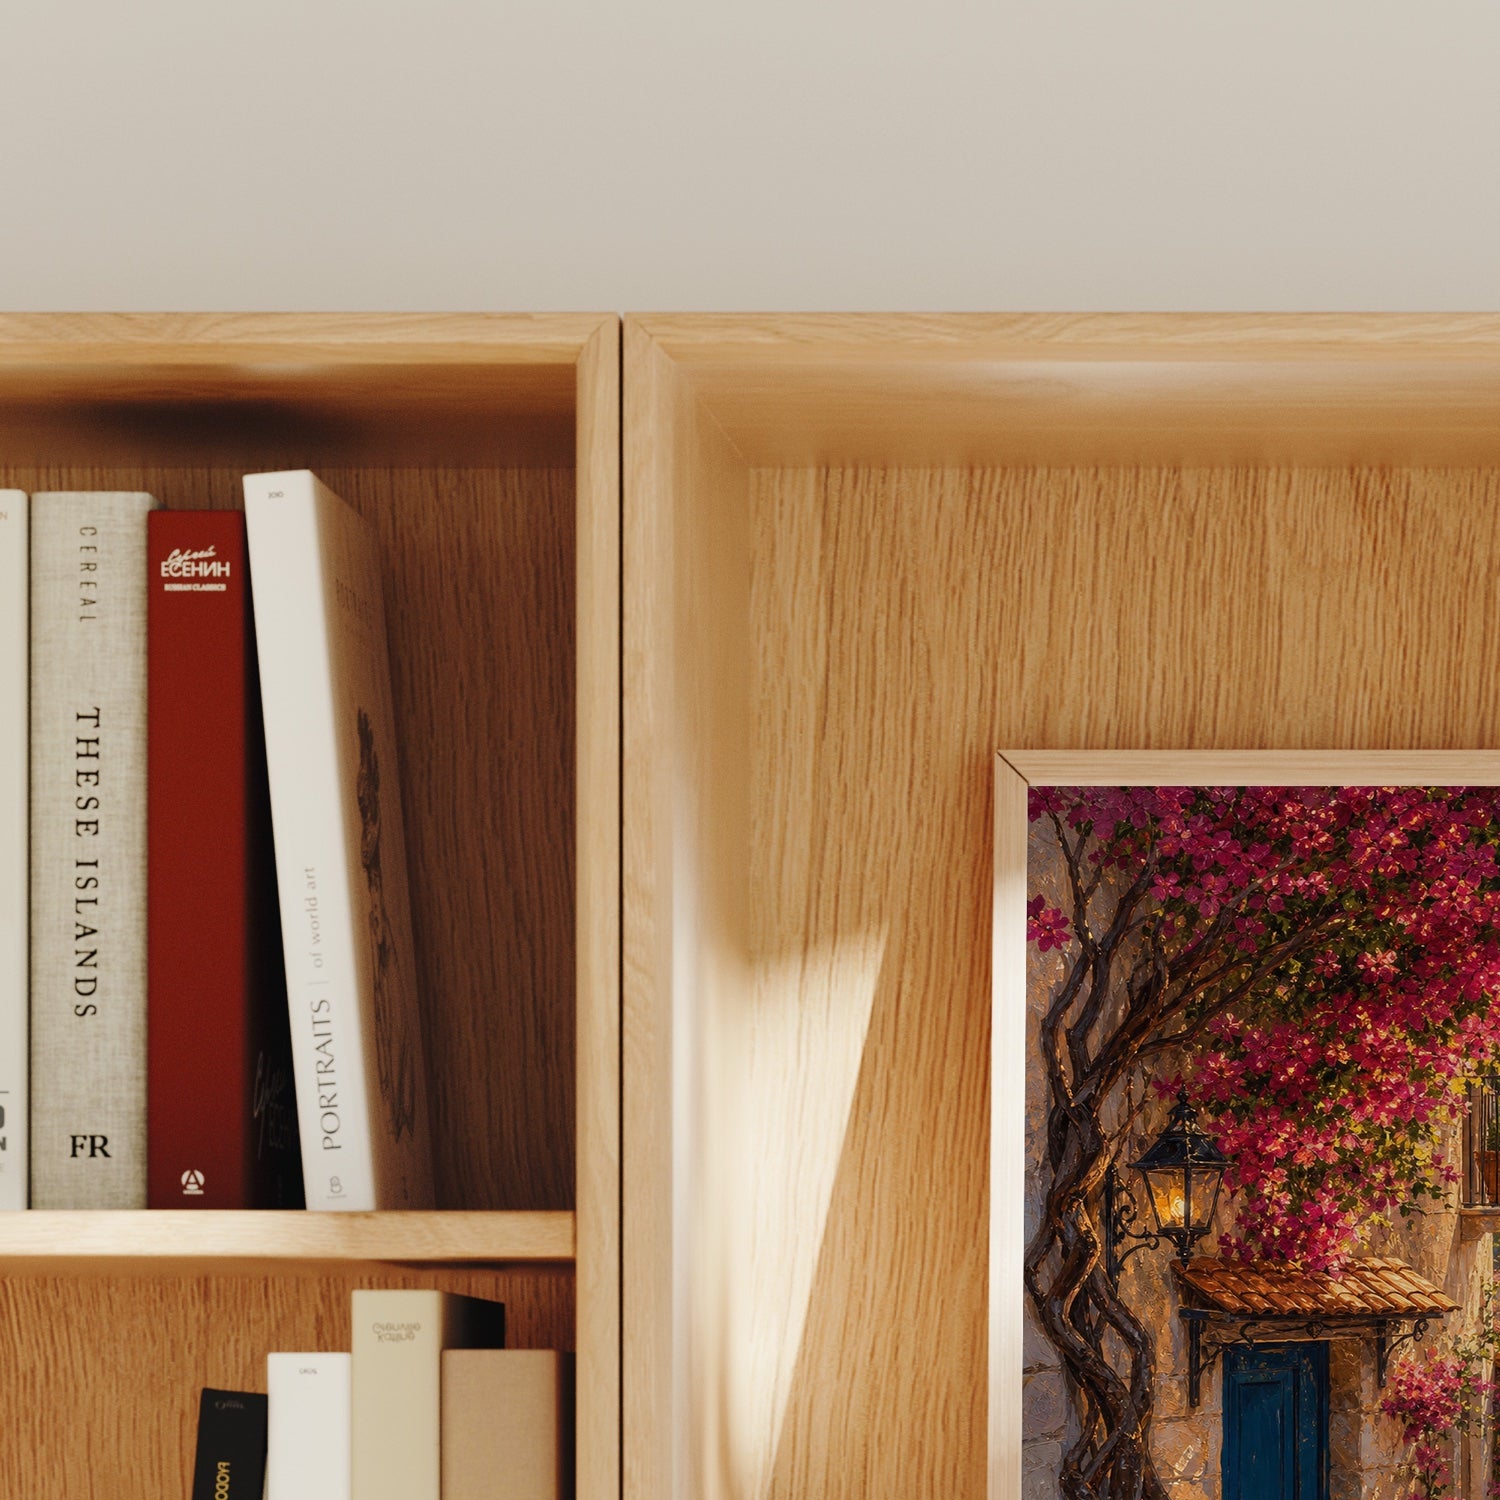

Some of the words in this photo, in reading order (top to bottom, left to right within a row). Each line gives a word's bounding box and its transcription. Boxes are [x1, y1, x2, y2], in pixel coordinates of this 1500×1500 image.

[79, 526, 98, 623] CEREAL
[160, 561, 231, 577] ЕСЕНИН
[75, 707, 101, 837] THESE
[305, 867, 317, 891] art
[75, 859, 99, 1018] ISLANDS
[305, 896, 322, 948] world
[312, 951, 324, 969] of
[310, 999, 342, 1151] PORTRAITS
[69, 1134, 112, 1158] FR
